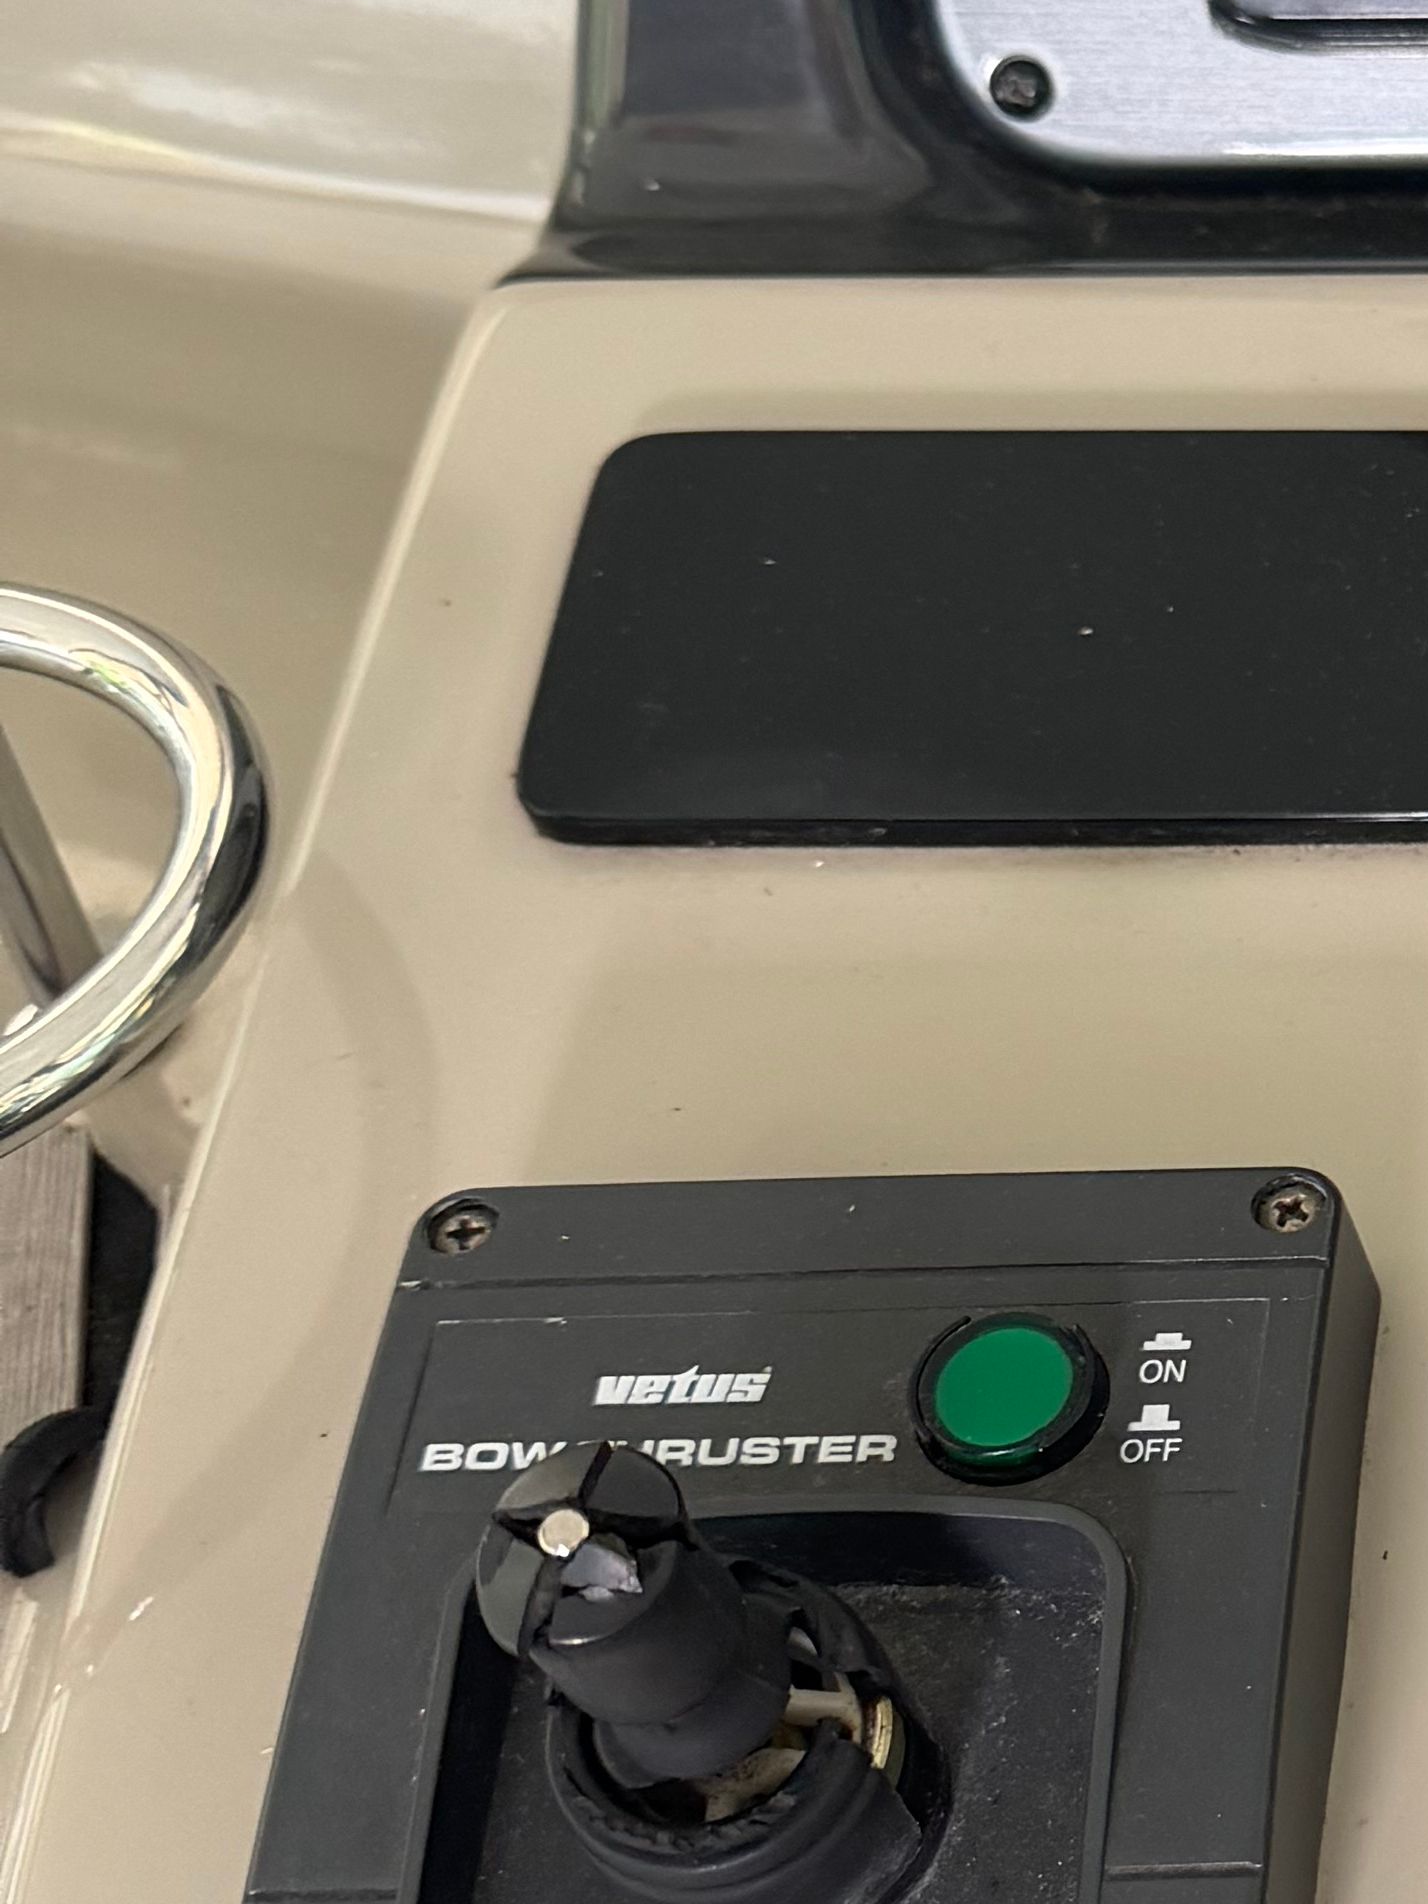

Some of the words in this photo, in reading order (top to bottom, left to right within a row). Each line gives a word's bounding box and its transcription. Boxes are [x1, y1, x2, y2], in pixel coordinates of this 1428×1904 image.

[594, 1366, 772, 1405] vetus
[1138, 1359, 1187, 1384] ON
[420, 1441, 568, 1472] BOW
[575, 1434, 898, 1468] RUSTER
[1120, 1439, 1181, 1464] OFF
